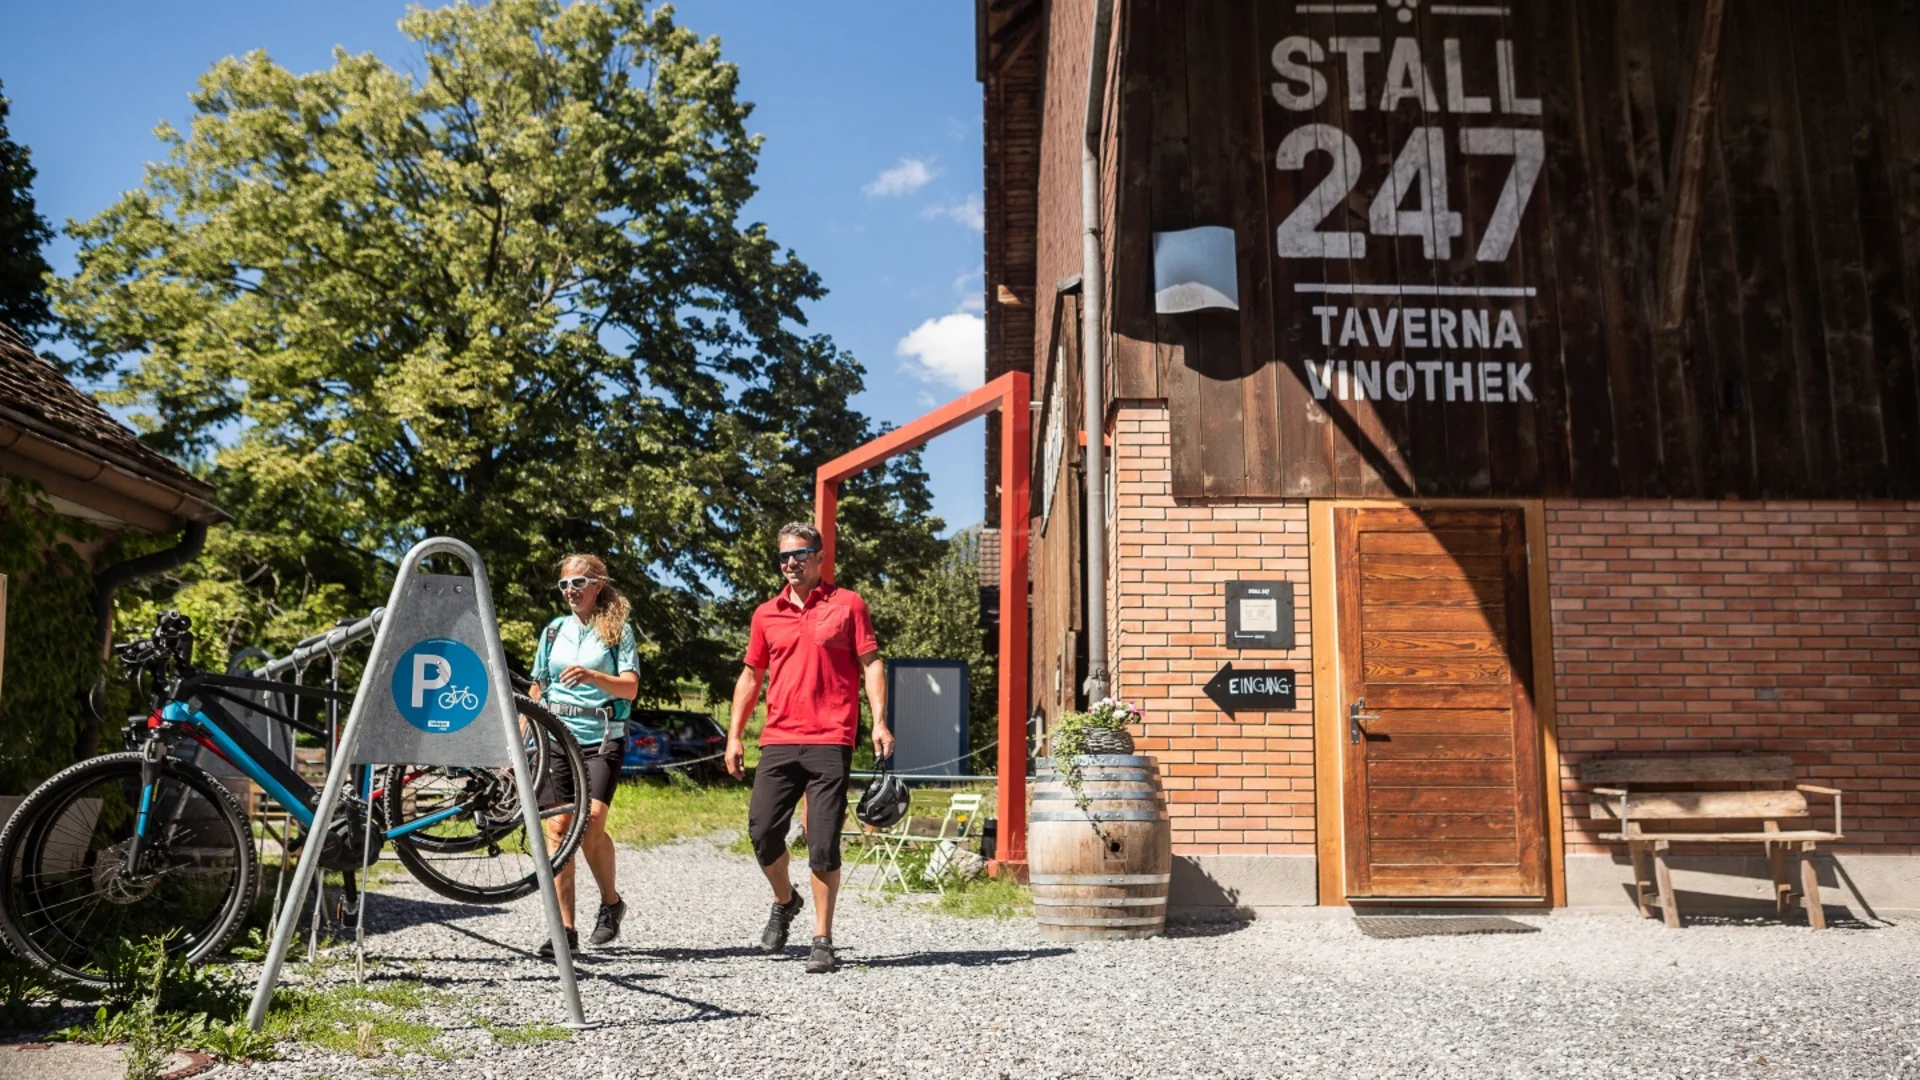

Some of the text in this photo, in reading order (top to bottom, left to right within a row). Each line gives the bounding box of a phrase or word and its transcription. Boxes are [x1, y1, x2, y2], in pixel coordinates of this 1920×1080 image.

[1271, 36, 1542, 115] STALL
[1276, 123, 1545, 262] 247
[1312, 306, 1523, 349] TAVERNA
[1304, 360, 1534, 402] VINOTHEK
[411, 653, 452, 708] P
[1229, 676, 1290, 695] EINGANG
